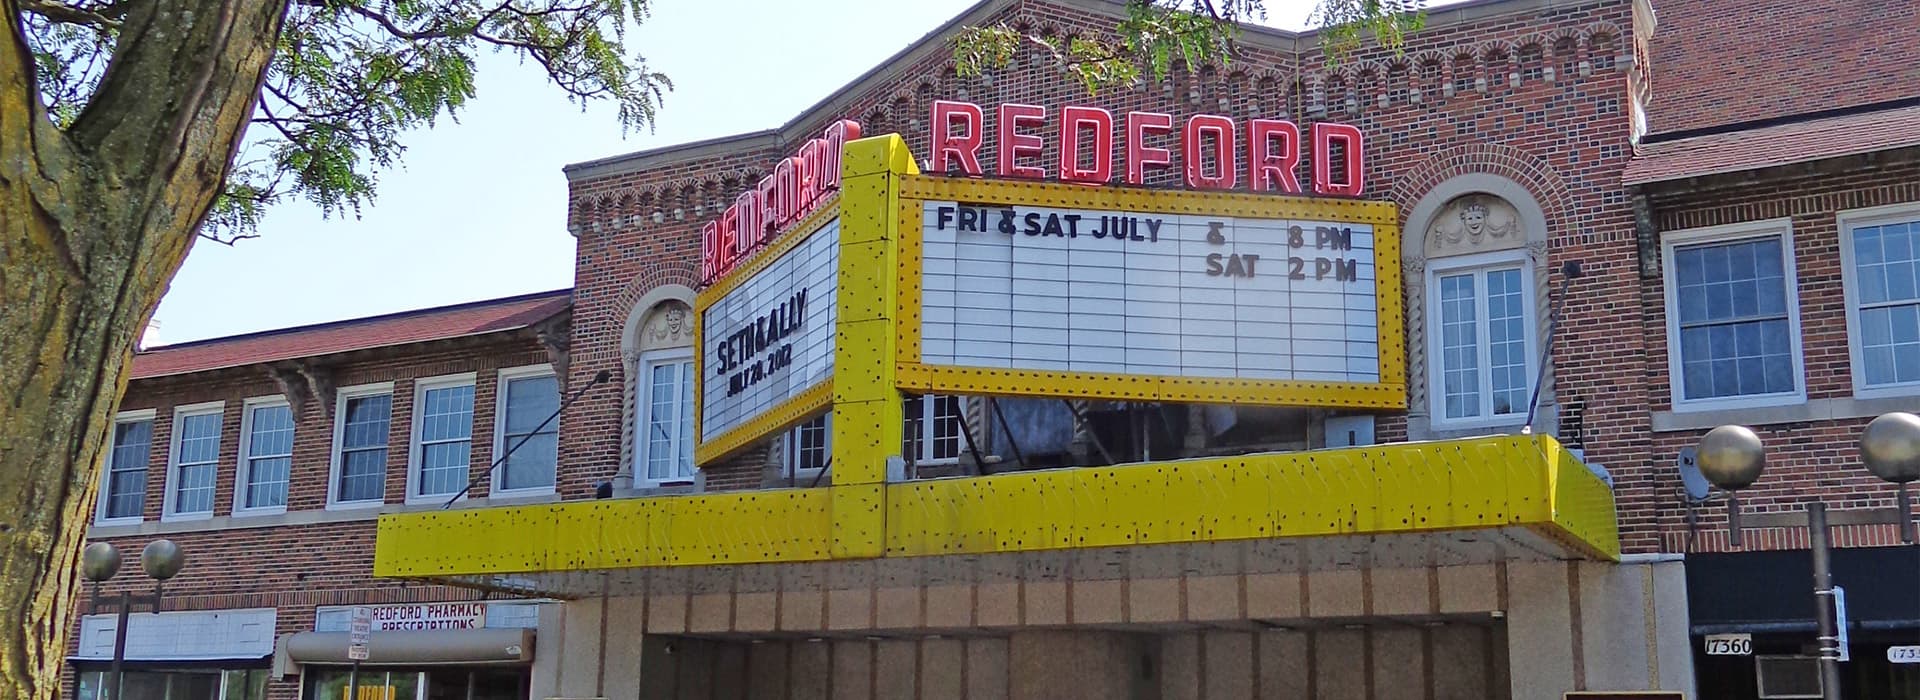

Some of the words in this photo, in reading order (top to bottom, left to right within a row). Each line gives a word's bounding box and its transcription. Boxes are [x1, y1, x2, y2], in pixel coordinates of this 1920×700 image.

[929, 99, 1364, 197] REDFORD
[701, 119, 860, 288] REDFORD
[937, 206, 987, 232] FRI
[1024, 212, 1081, 238] SAT
[1092, 215, 1162, 242] JULY
[1206, 221, 1225, 245] &
[1288, 225, 1304, 249] 8
[1315, 226, 1351, 251] PM
[1206, 253, 1259, 278] SAT
[1289, 256, 1305, 280] 2
[1315, 257, 1356, 282] PM
[373, 606, 421, 620] REDFORD
[428, 603, 486, 618] PHARMACY
[1706, 639, 1752, 654] 17360
